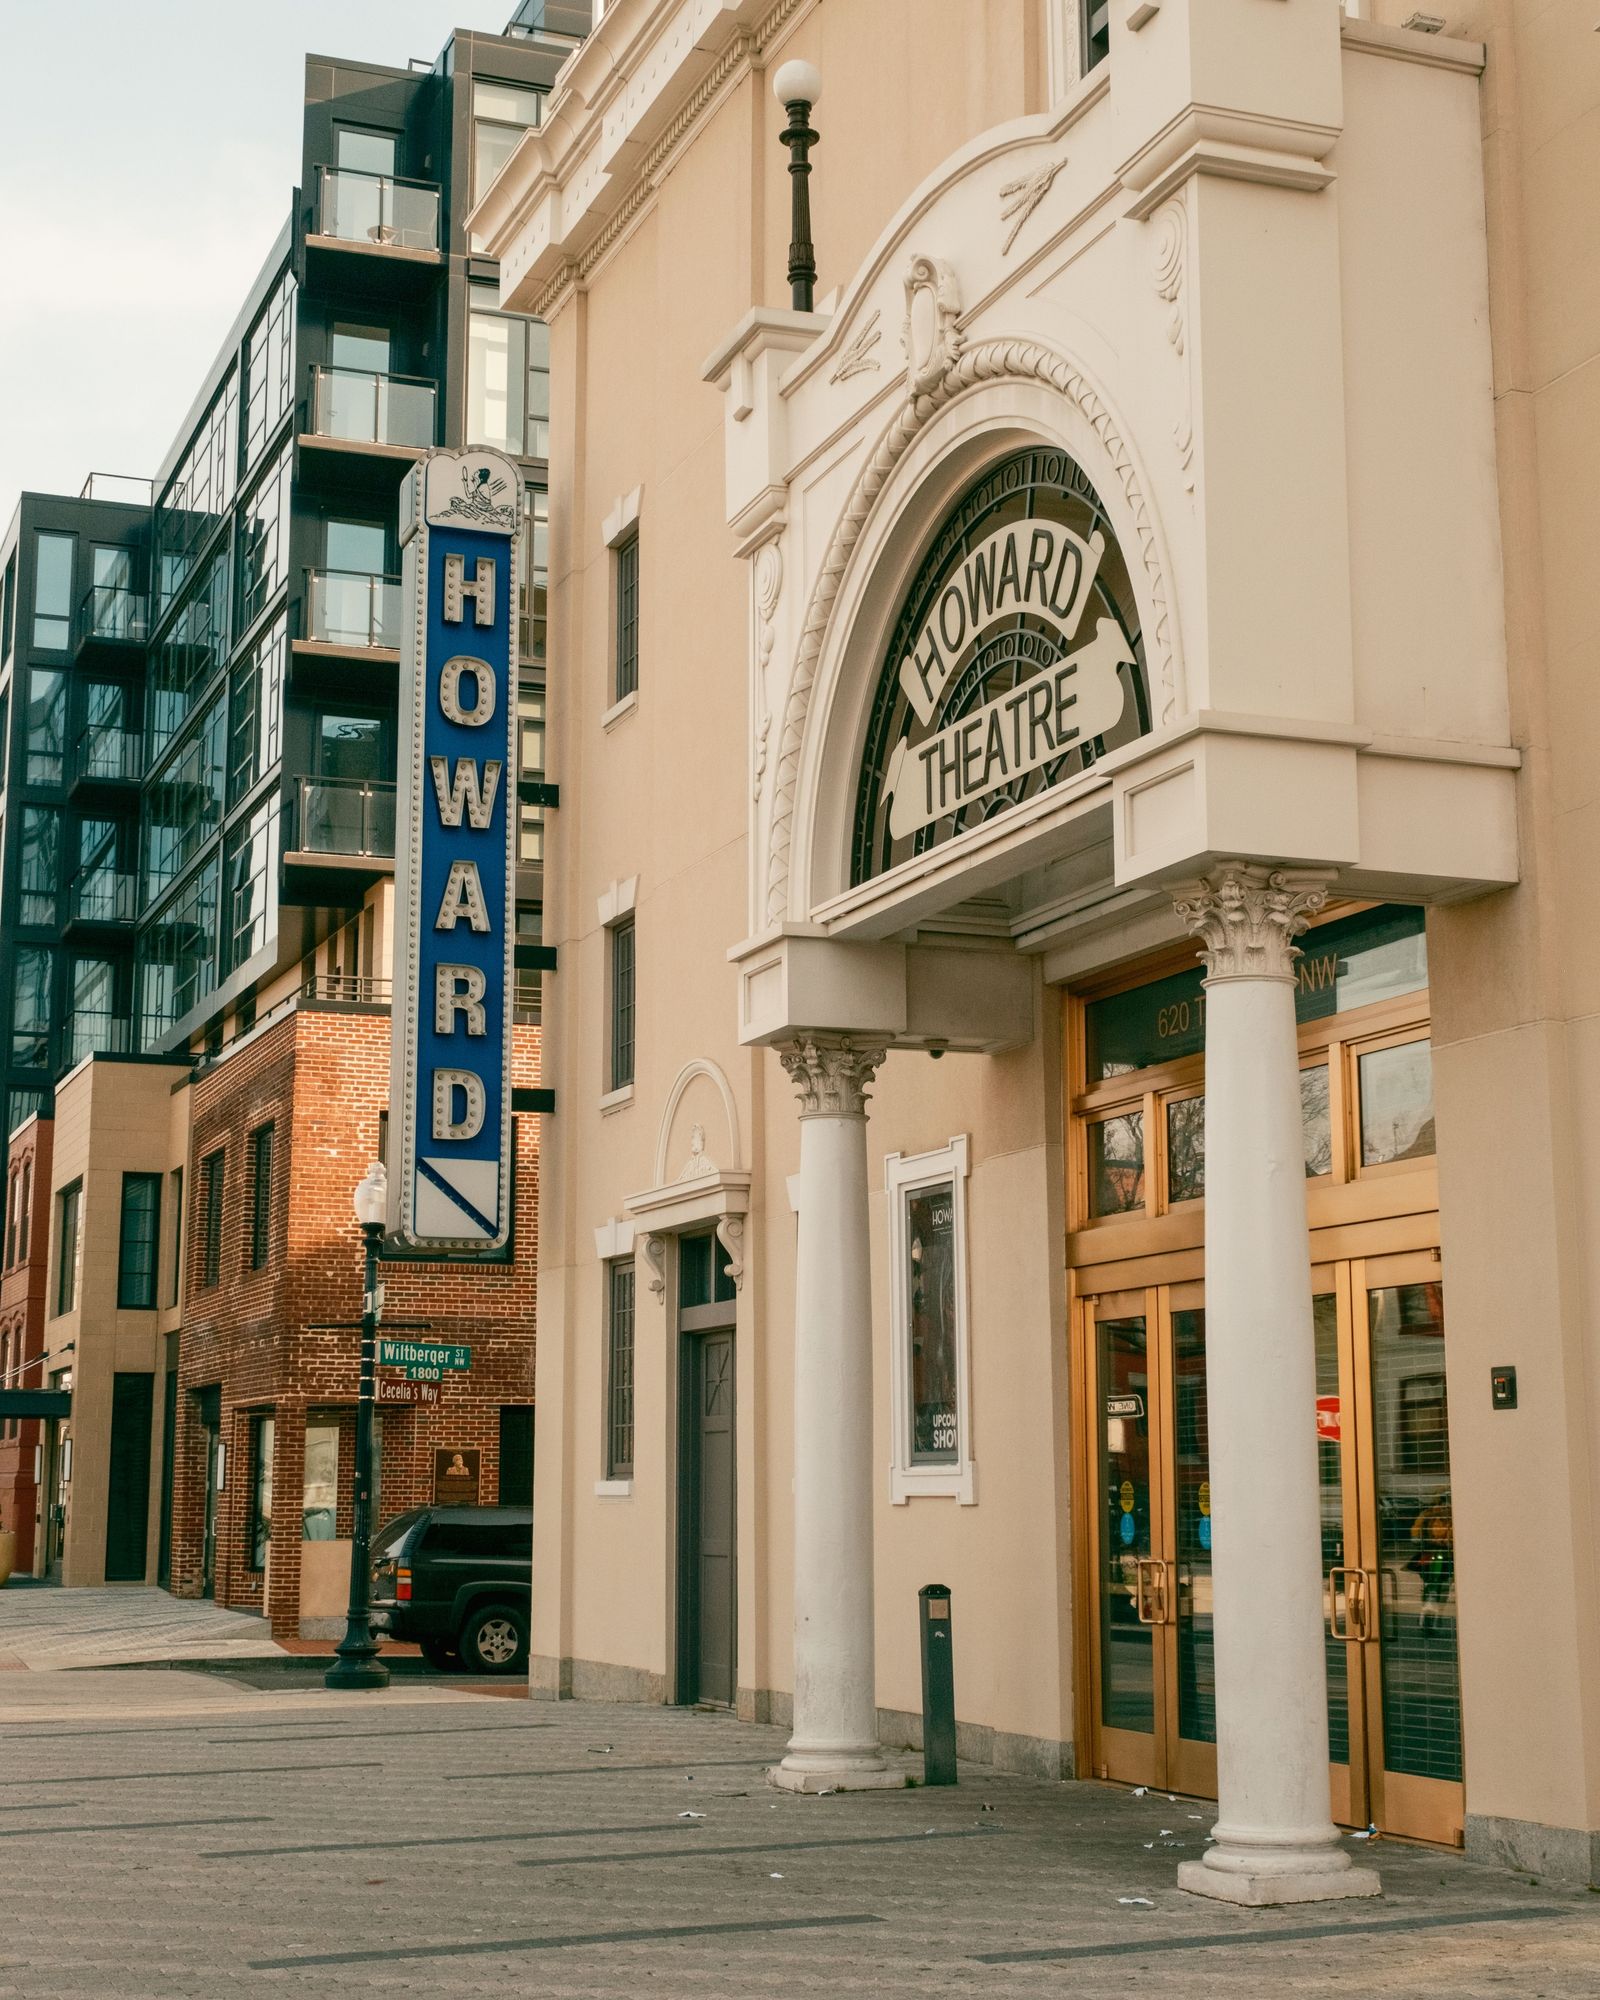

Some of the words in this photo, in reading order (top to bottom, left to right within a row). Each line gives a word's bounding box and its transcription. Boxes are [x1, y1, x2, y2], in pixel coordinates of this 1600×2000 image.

[914, 528, 1083, 703] HOWARD
[918, 663, 1080, 814] THEATRE
[430, 552, 503, 1141] HOWARD
[1158, 1001, 1189, 1038] 620
[1300, 952, 1337, 995] NW
[384, 1343, 450, 1365] Wiltberger
[455, 1349, 464, 1357] ST
[410, 1366, 439, 1380] 1800
[454, 1358, 465, 1366] NW
[380, 1380, 418, 1401] Cecelia's
[421, 1384, 438, 1405] Way
